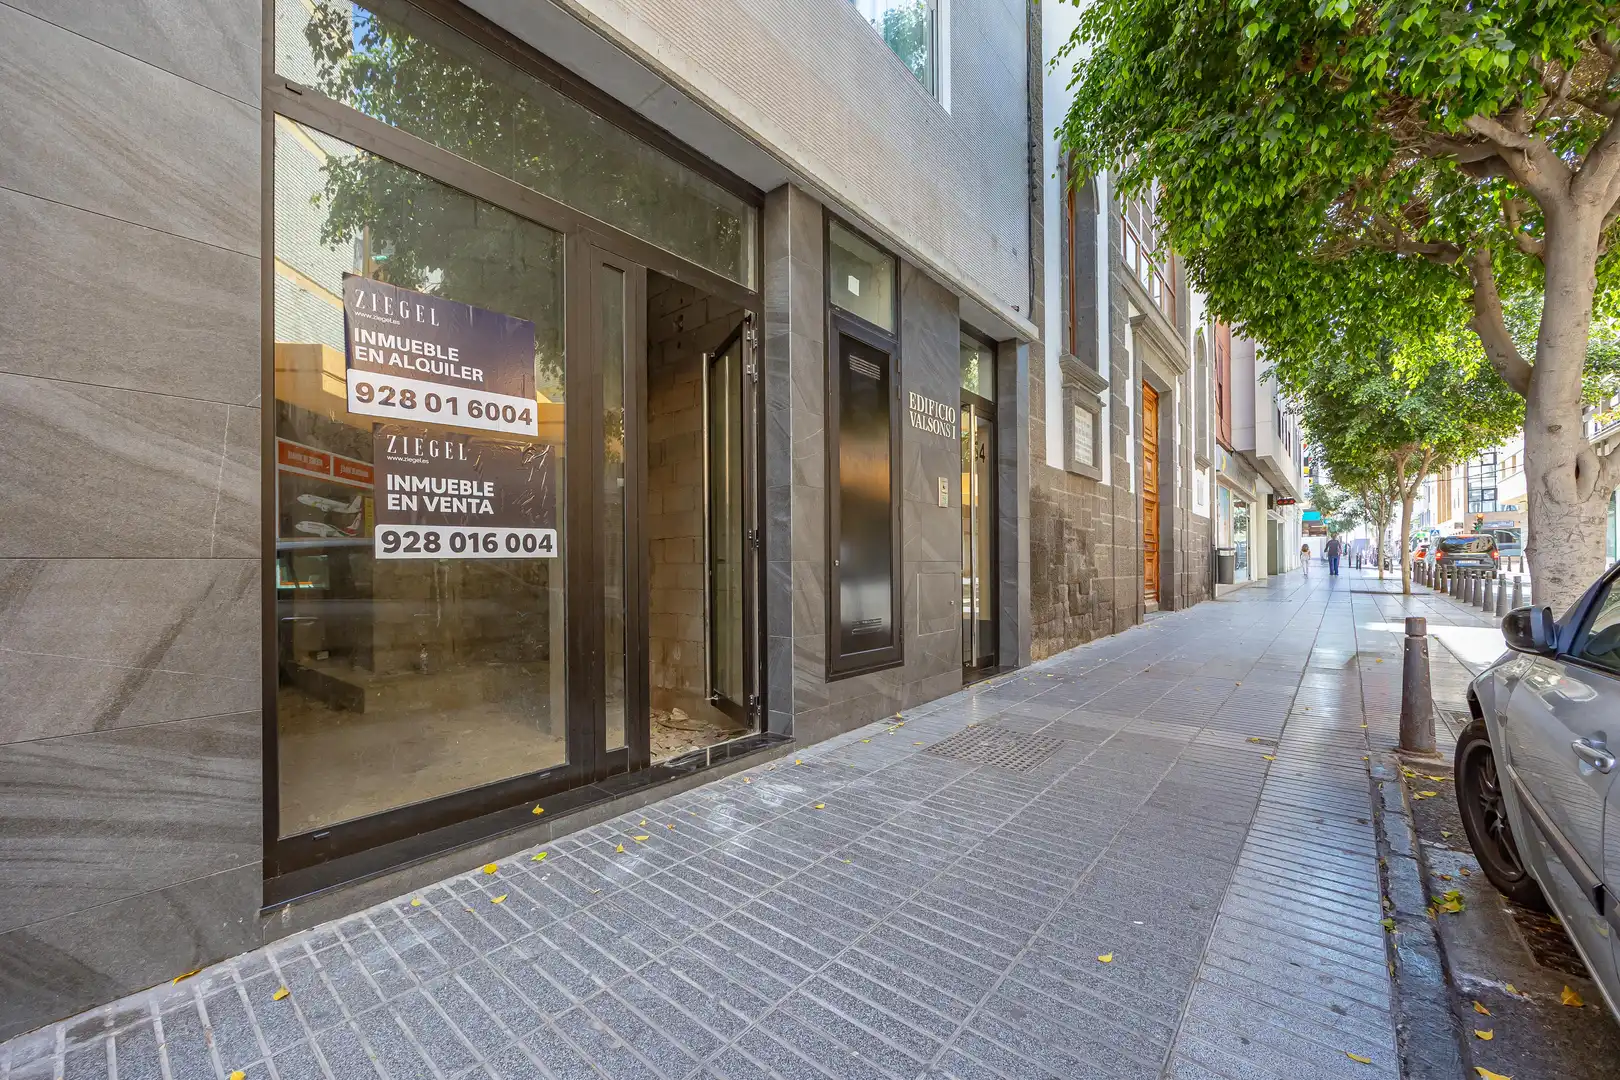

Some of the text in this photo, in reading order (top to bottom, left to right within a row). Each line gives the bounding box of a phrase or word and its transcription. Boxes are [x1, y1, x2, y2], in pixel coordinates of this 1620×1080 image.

[354, 311, 400, 325] www.ziegel.es
[355, 289, 440, 327] ZIEGEL
[354, 327, 459, 362] INMUEBLE
[355, 345, 484, 382] EN ALQUILER
[355, 382, 417, 410] 928
[909, 391, 956, 424] EDIFICIO
[909, 410, 956, 440] VALSONS I
[386, 434, 468, 461] ZIEGEL
[386, 455, 430, 465] www.ziegel.es
[386, 473, 495, 497] INMUEBLE
[387, 493, 495, 515] EN VENTA
[381, 530, 553, 554] 928 016 004
